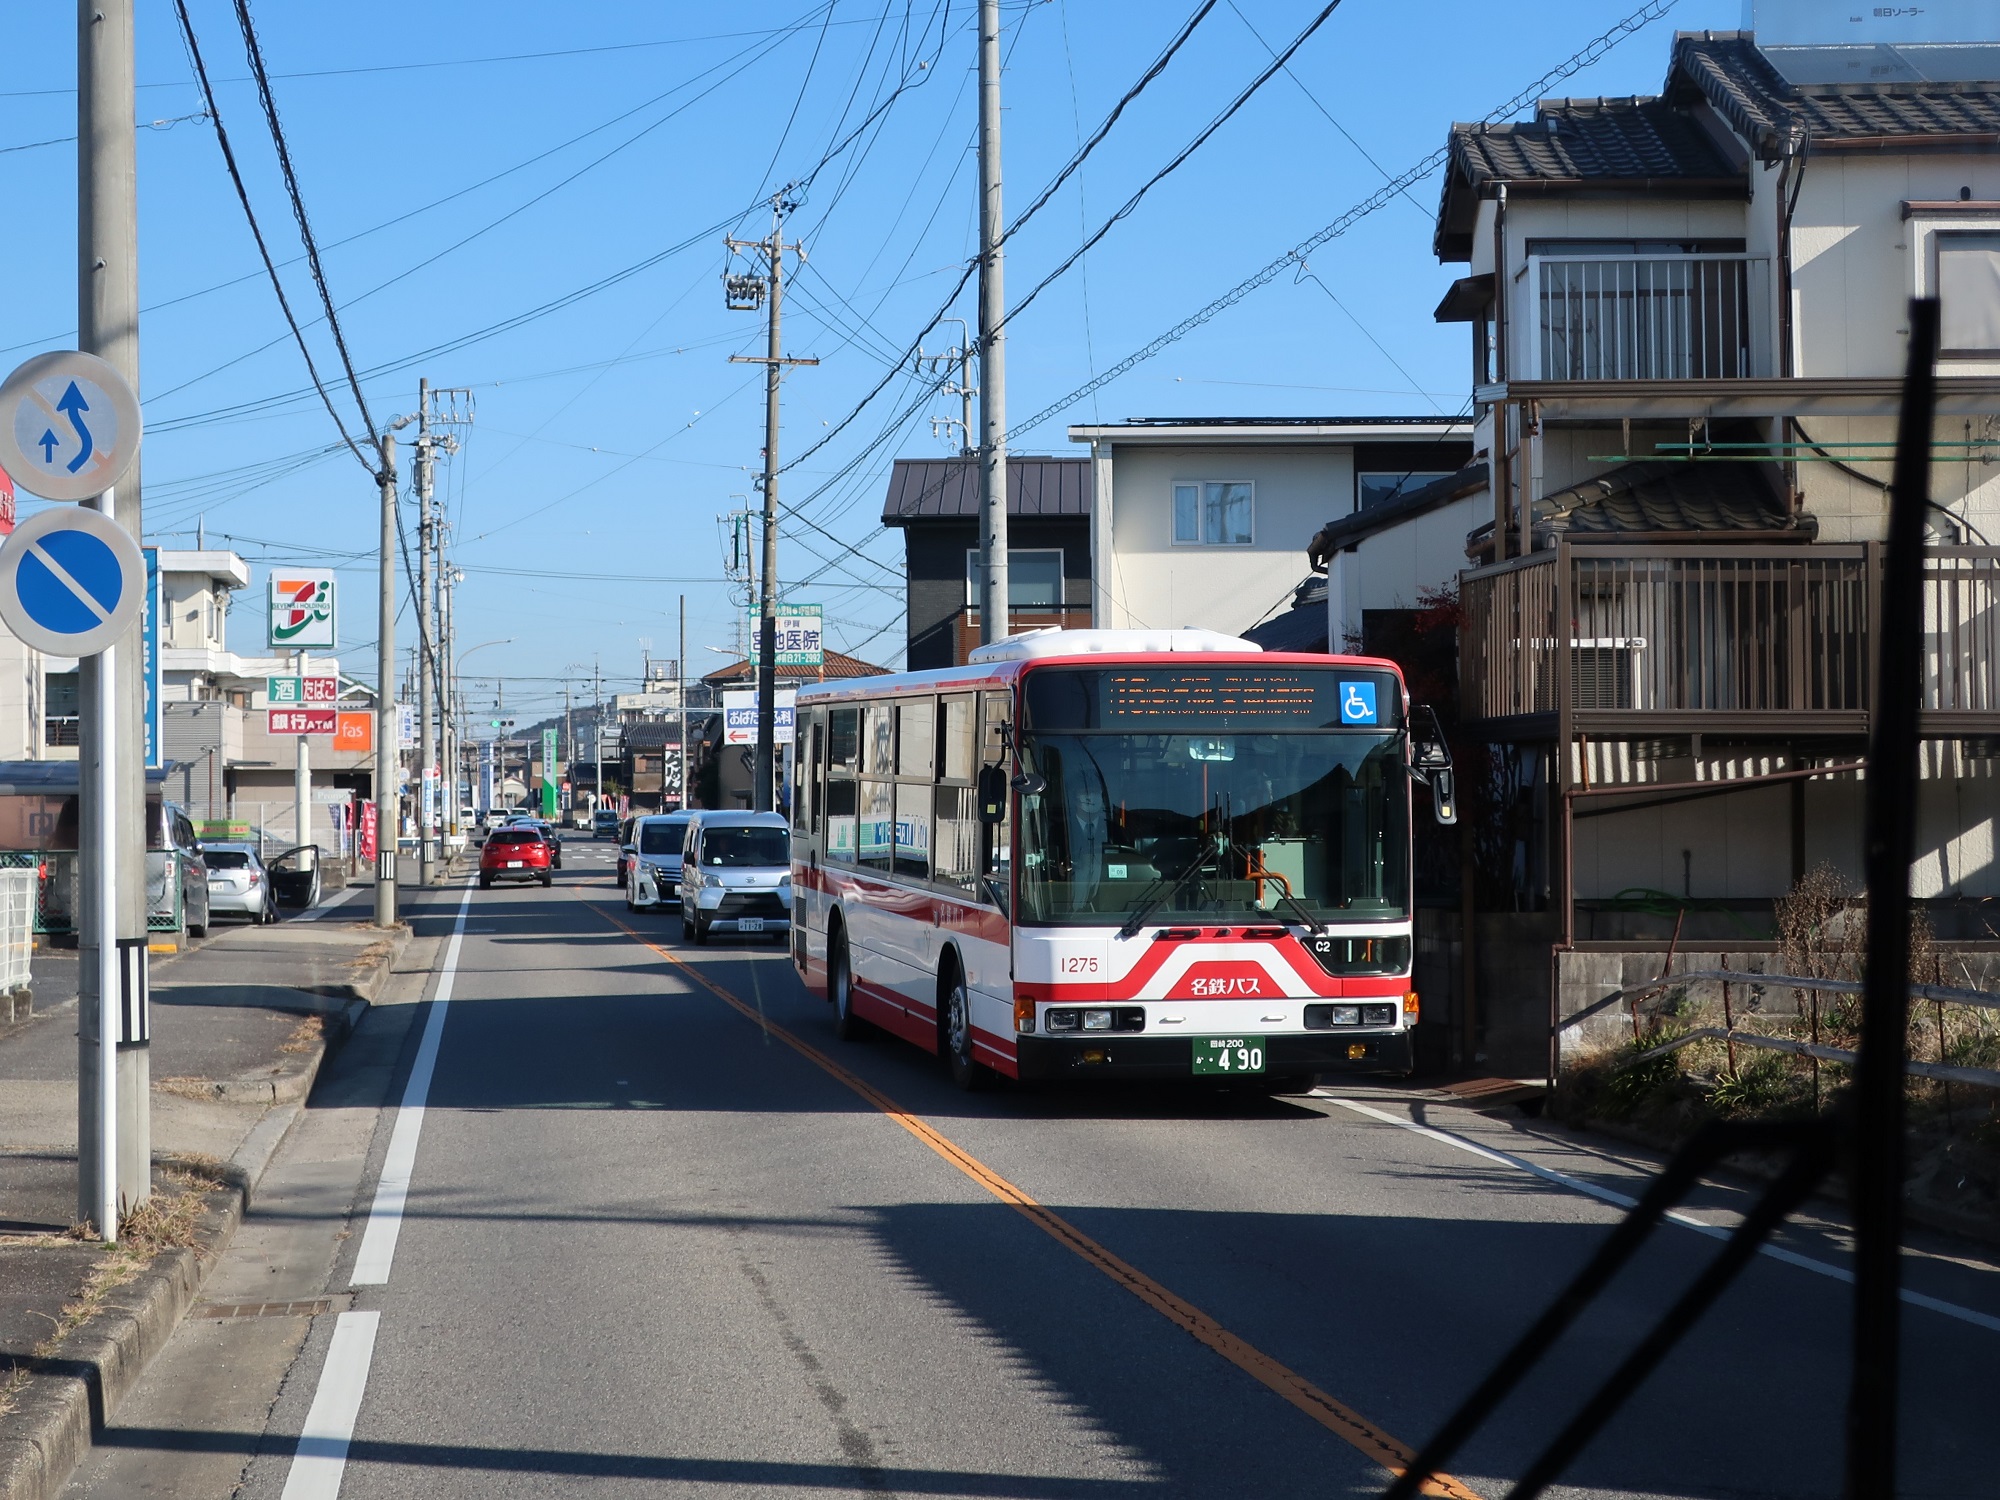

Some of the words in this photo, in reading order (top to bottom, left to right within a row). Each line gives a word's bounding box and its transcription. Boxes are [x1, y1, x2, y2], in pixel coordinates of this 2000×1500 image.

[1873, 7, 1925, 17] 朝日ソーラー
[275, 679, 296, 701] 酒
[303, 679, 335, 701] たばこ
[342, 721, 363, 738] fas
[1315, 940, 1331, 953] C2
[1060, 957, 1098, 973] 1275
[1190, 977, 1261, 996] 名鉄バス
